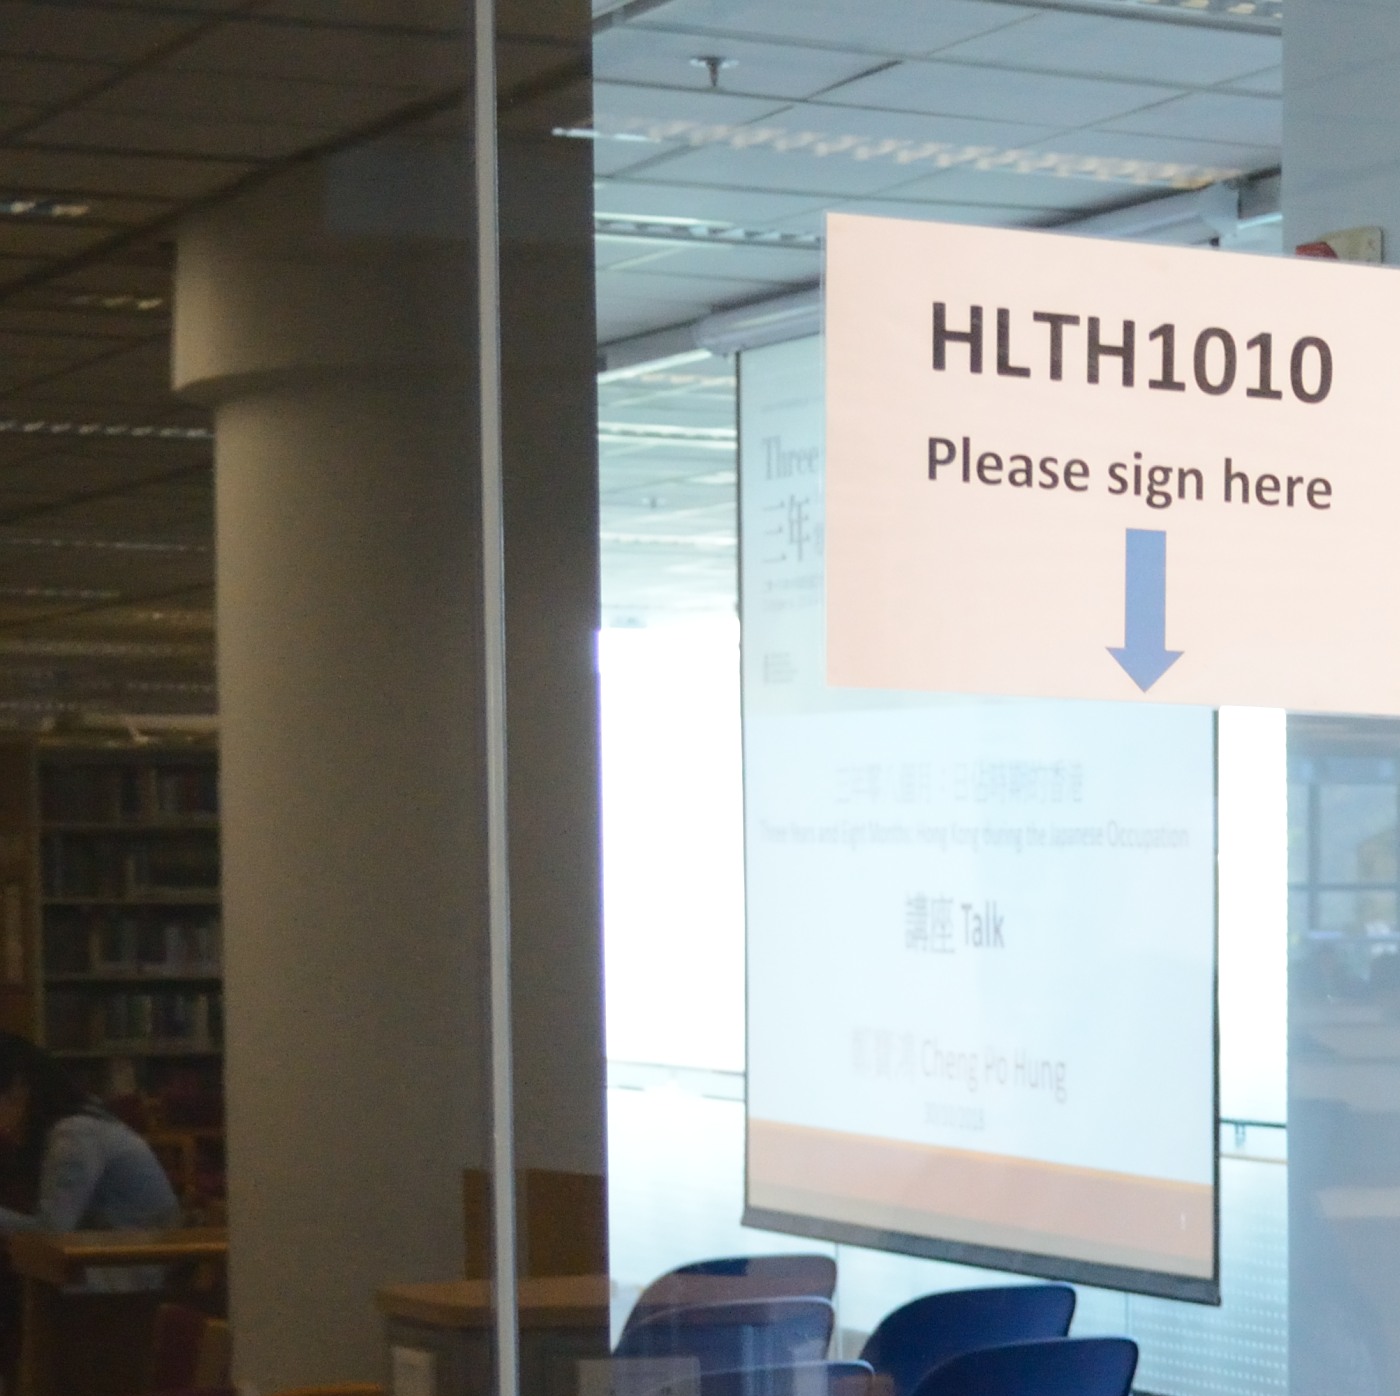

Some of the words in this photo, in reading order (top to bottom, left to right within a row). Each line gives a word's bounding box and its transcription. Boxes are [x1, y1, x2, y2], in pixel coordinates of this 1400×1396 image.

[932, 301, 1333, 404] HLTH1010
[927, 436, 1090, 492] Please
[1107, 451, 1204, 509] sign
[1223, 457, 1332, 510] here
[982, 822, 1023, 854] during
[1026, 824, 1049, 848] the
[1050, 825, 1105, 852] Japanese
[1107, 820, 1189, 854] Occupation
[904, 890, 956, 955] 講座
[960, 899, 1006, 951] Talk
[921, 1036, 979, 1093] Cheng
[984, 1044, 1008, 1086] Po
[1013, 1046, 1069, 1105] Hung
